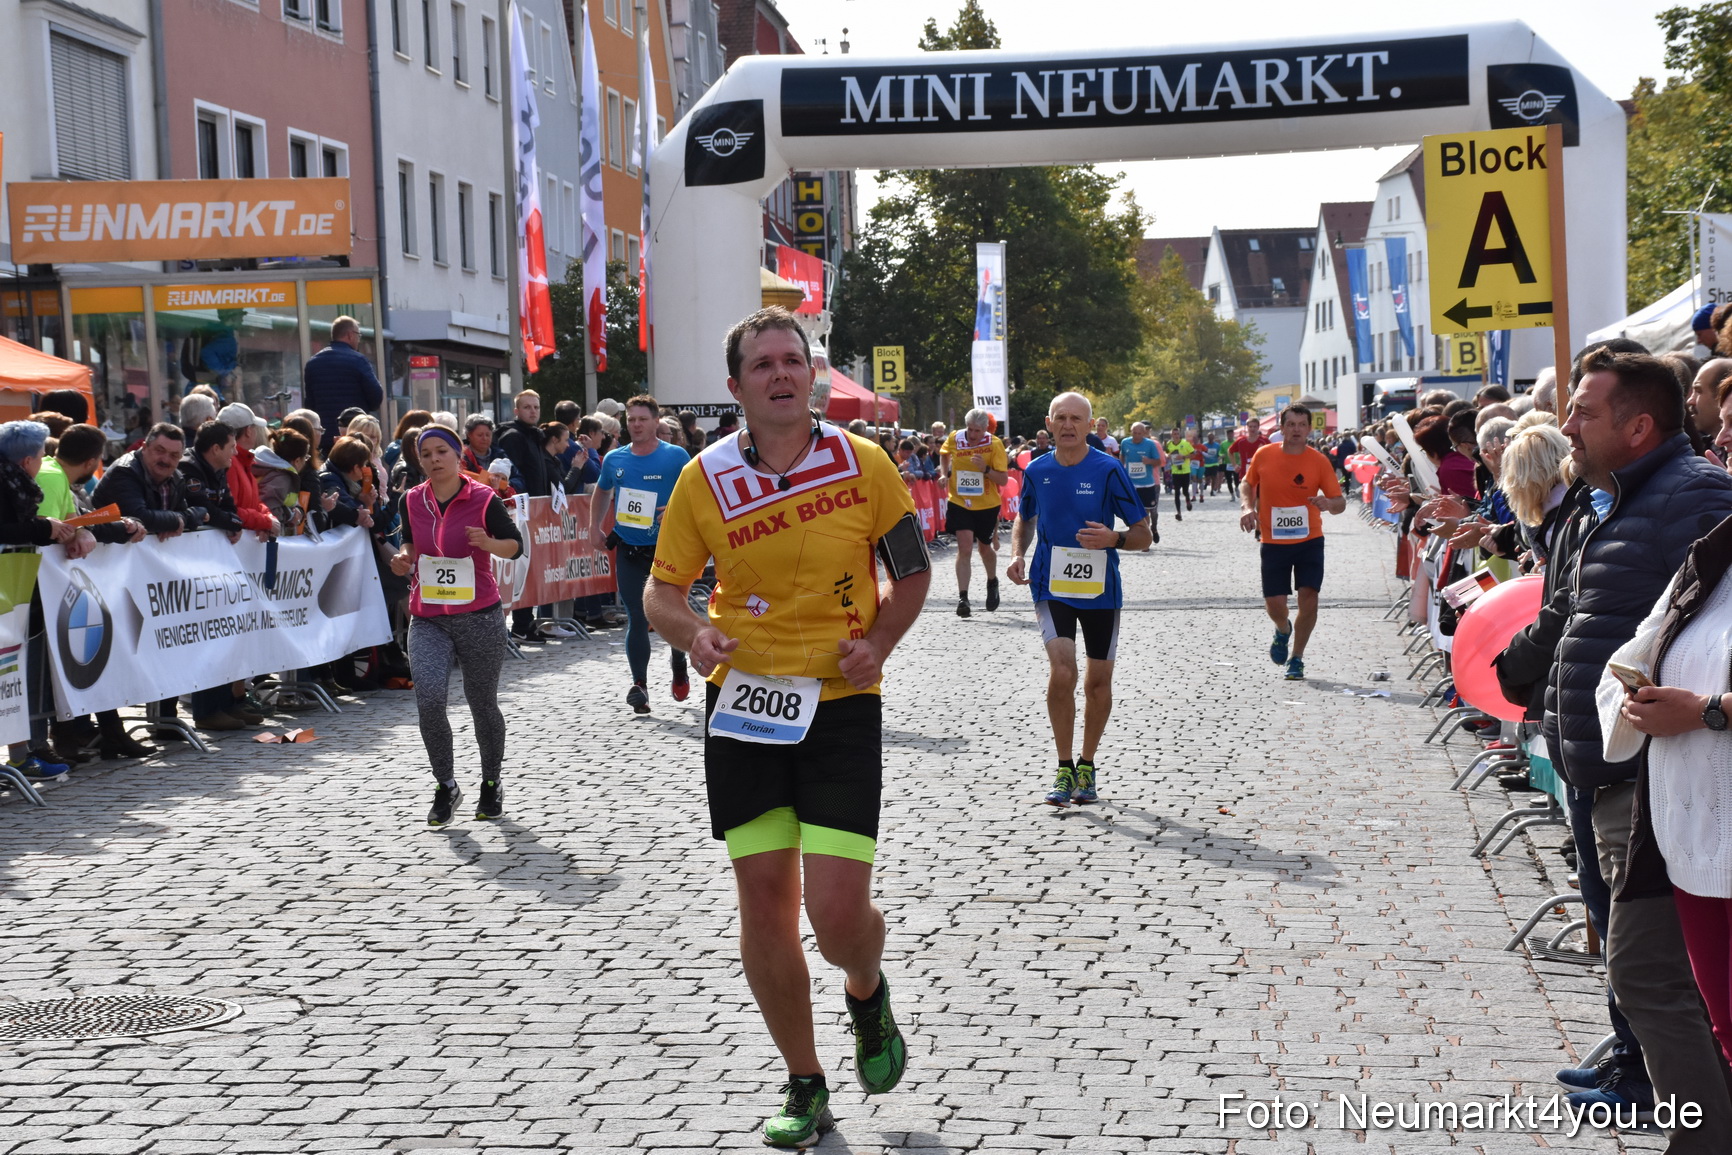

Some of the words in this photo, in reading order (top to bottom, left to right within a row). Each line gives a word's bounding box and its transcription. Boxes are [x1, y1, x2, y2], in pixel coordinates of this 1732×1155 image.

[840, 72, 992, 123] MINI
[1010, 50, 1402, 119] NEUMARKT.
[1521, 100, 1544, 110] MINI
[713, 138, 735, 147] MINI
[1440, 135, 1548, 178] Block
[22, 199, 335, 243] RUNMARKT.DE
[1457, 190, 1538, 289] A
[167, 287, 286, 307] RUNMARKT.DE
[876, 347, 901, 357] Block
[1459, 341, 1477, 365] B
[881, 360, 898, 383] B
[960, 478, 980, 487] 2638
[627, 500, 642, 514] 66
[727, 510, 792, 550] MAX
[795, 487, 868, 523] BÖGL
[1276, 516, 1304, 528] 2068
[436, 568, 456, 585] 25
[1063, 563, 1093, 579] 429
[147, 578, 192, 617] BMW
[154, 621, 201, 650] WENIGER
[731, 683, 802, 721] 2608
[741, 722, 776, 735] Florian
